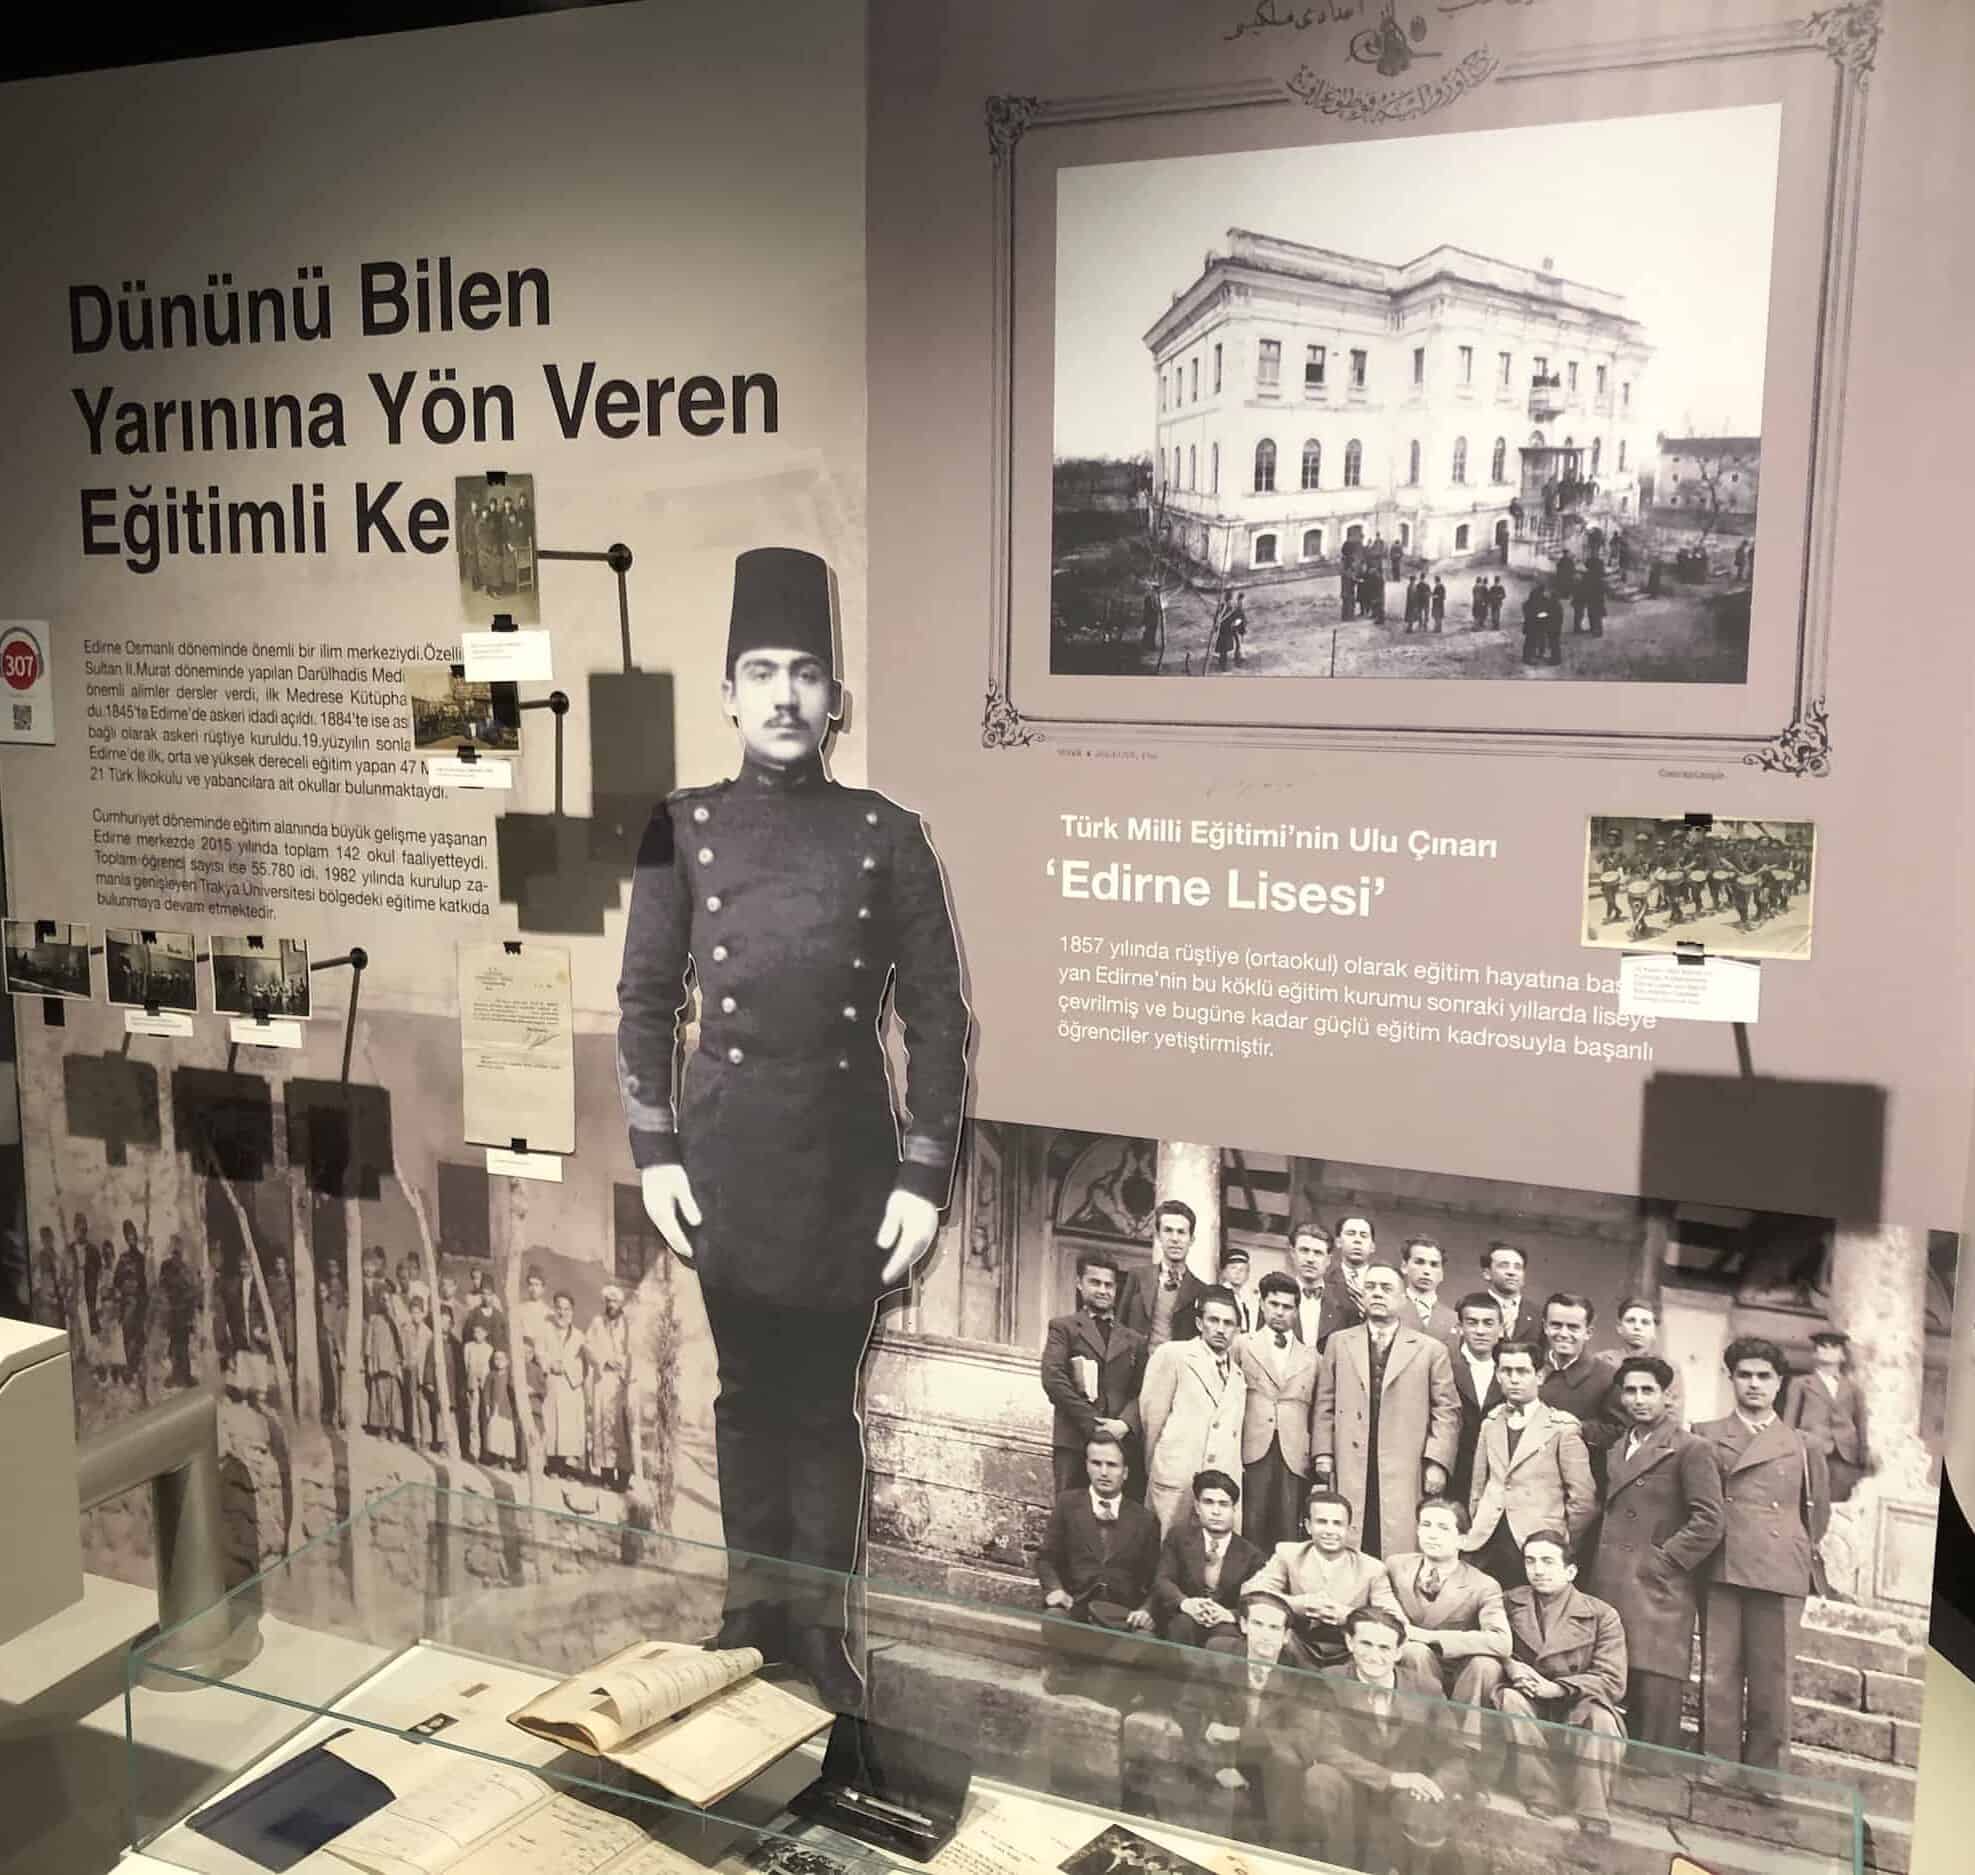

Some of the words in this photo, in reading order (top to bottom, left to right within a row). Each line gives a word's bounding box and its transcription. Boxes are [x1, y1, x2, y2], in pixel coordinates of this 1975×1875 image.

[69, 265, 331, 354] Dününü
[361, 256, 550, 336] Bilen
[71, 386, 346, 455] Yarınına
[367, 367, 514, 446] Yön
[542, 361, 778, 439] Veren
[80, 482, 327, 575] Eğitimli
[355, 481, 449, 554] Ke
[6, 656, 33, 677] 307
[84, 640, 121, 655] Edirne
[124, 640, 175, 656] Osmanlı
[178, 642, 248, 657] döneminde
[253, 642, 295, 658] önemli
[299, 643, 315, 658] bir
[320, 643, 343, 659] ilim
[347, 643, 463, 664] merkeziydi.Özelli
[85, 661, 122, 676] Sultan
[126, 662, 171, 678] II.Murat
[175, 664, 244, 679] döneminde
[248, 665, 293, 683] yapılan
[297, 665, 368, 682] Darülhadis
[86, 684, 124, 697] önemli
[131, 685, 170, 699] alimler
[176, 686, 218, 700] dersler
[225, 687, 259, 702] verdi,
[265, 687, 279, 700] ilk
[287, 688, 343, 704] Medrese
[350, 690, 408, 710] Kütüpha
[151, 705, 207, 722] Edirne'de
[209, 708, 245, 723] askeri
[249, 709, 278, 724] idadi
[281, 711, 315, 728] açıldı.
[321, 711, 368, 728] 1884'te
[371, 715, 390, 728] ise
[393, 717, 408, 729] as
[88, 726, 117, 743] bağlı
[121, 727, 157, 742] olarak
[163, 728, 198, 744] askeri
[204, 730, 245, 748] rüştiye
[376, 736, 412, 752] sonla
[89, 745, 145, 762] Edirne'de
[148, 749, 165, 764] ilk,
[168, 750, 192, 764] orta
[195, 753, 209, 765] ve
[211, 751, 256, 768] yüksek
[259, 753, 309, 770] dereceli
[312, 755, 352, 774] eğitim
[355, 760, 396, 776] yapan
[400, 760, 416, 774] 47
[90, 767, 104, 781] 21
[108, 767, 134, 782] Türk
[187, 775, 200, 786] ve
[204, 773, 275, 790] yabancılara
[280, 777, 295, 791] ait
[298, 778, 341, 793] okullar
[345, 780, 448, 801] bulunmaktaydı.
[93, 808, 159, 827] Cumhuriyet
[163, 813, 231, 831] döneminde
[233, 817, 271, 835] eğitim
[274, 821, 328, 838] alanında
[331, 824, 371, 842] büyük
[374, 825, 427, 844] gelişme
[430, 832, 487, 849] yaşanan
[1060, 814, 1120, 840] Türk
[1127, 817, 1182, 843] Milli
[1350, 826, 1398, 853] Ulu
[1407, 829, 1498, 861] Çınarı
[94, 829, 131, 846] Edirne
[137, 833, 195, 850] merkezde
[201, 836, 232, 852] 2015
[238, 838, 278, 855] yılında
[285, 843, 329, 860] toplam
[336, 845, 360, 861] 142
[367, 848, 395, 864] okul
[402, 849, 488, 872] faaliyetteydi.
[94, 850, 137, 867] Toplam
[141, 853, 185, 871] öğrenci
[190, 857, 224, 874] sayısı
[229, 860, 246, 874] ise
[251, 861, 295, 878] 55.780
[300, 866, 319, 880] idi.
[325, 866, 356, 883] 1982
[362, 870, 405, 887] yılında
[410, 873, 462, 892] kurulup
[466, 879, 489, 893] za-
[96, 872, 131, 887] manla
[134, 875, 197, 892] genişleyen
[200, 878, 240, 898] Trakya
[242, 880, 316, 901] Üniversitesi
[319, 889, 384, 908] bölgedeki
[386, 893, 436, 912] eğitime
[439, 897, 490, 915] katkıda
[97, 892, 160, 911] bulunmaya
[165, 898, 205, 913] devam
[208, 903, 277, 921] etmektedir.
[1059, 935, 1104, 953] 1857
[1110, 939, 1169, 960] yılında
[1175, 944, 1240, 967] rüştiye
[1245, 948, 1338, 977] (ortaokul)
[1344, 957, 1408, 978] olarak
[1413, 960, 1480, 985] eğitim
[1486, 965, 1580, 991] hayatına
[1058, 967, 1090, 984] yan
[1095, 965, 1187, 991] Edirne'nin
[1192, 974, 1217, 992] bu
[1221, 976, 1273, 997] köklü
[1278, 981, 1338, 1004] eğitim
[1344, 986, 1422, 1009] kurumu
[1427, 995, 1504, 1017] sonraki
[1509, 1001, 1587, 1024] yıllarda
[1593, 1006, 1657, 1032] liseye
[1058, 994, 1139, 1019] çevrilmiş
[1145, 1002, 1167, 1018] ve
[1172, 1001, 1246, 1025] bugüne
[1251, 1008, 1308, 1030] kadar
[1314, 1016, 1369, 1038] güçlü
[1376, 1019, 1440, 1043] eğitim
[1447, 1025, 1566, 1055] kadrosuyla
[1574, 1036, 1654, 1063] başarılı
[1058, 1020, 1149, 1043] öğrenciler
[1154, 1031, 1275, 1059] yetiştirmiştir.
